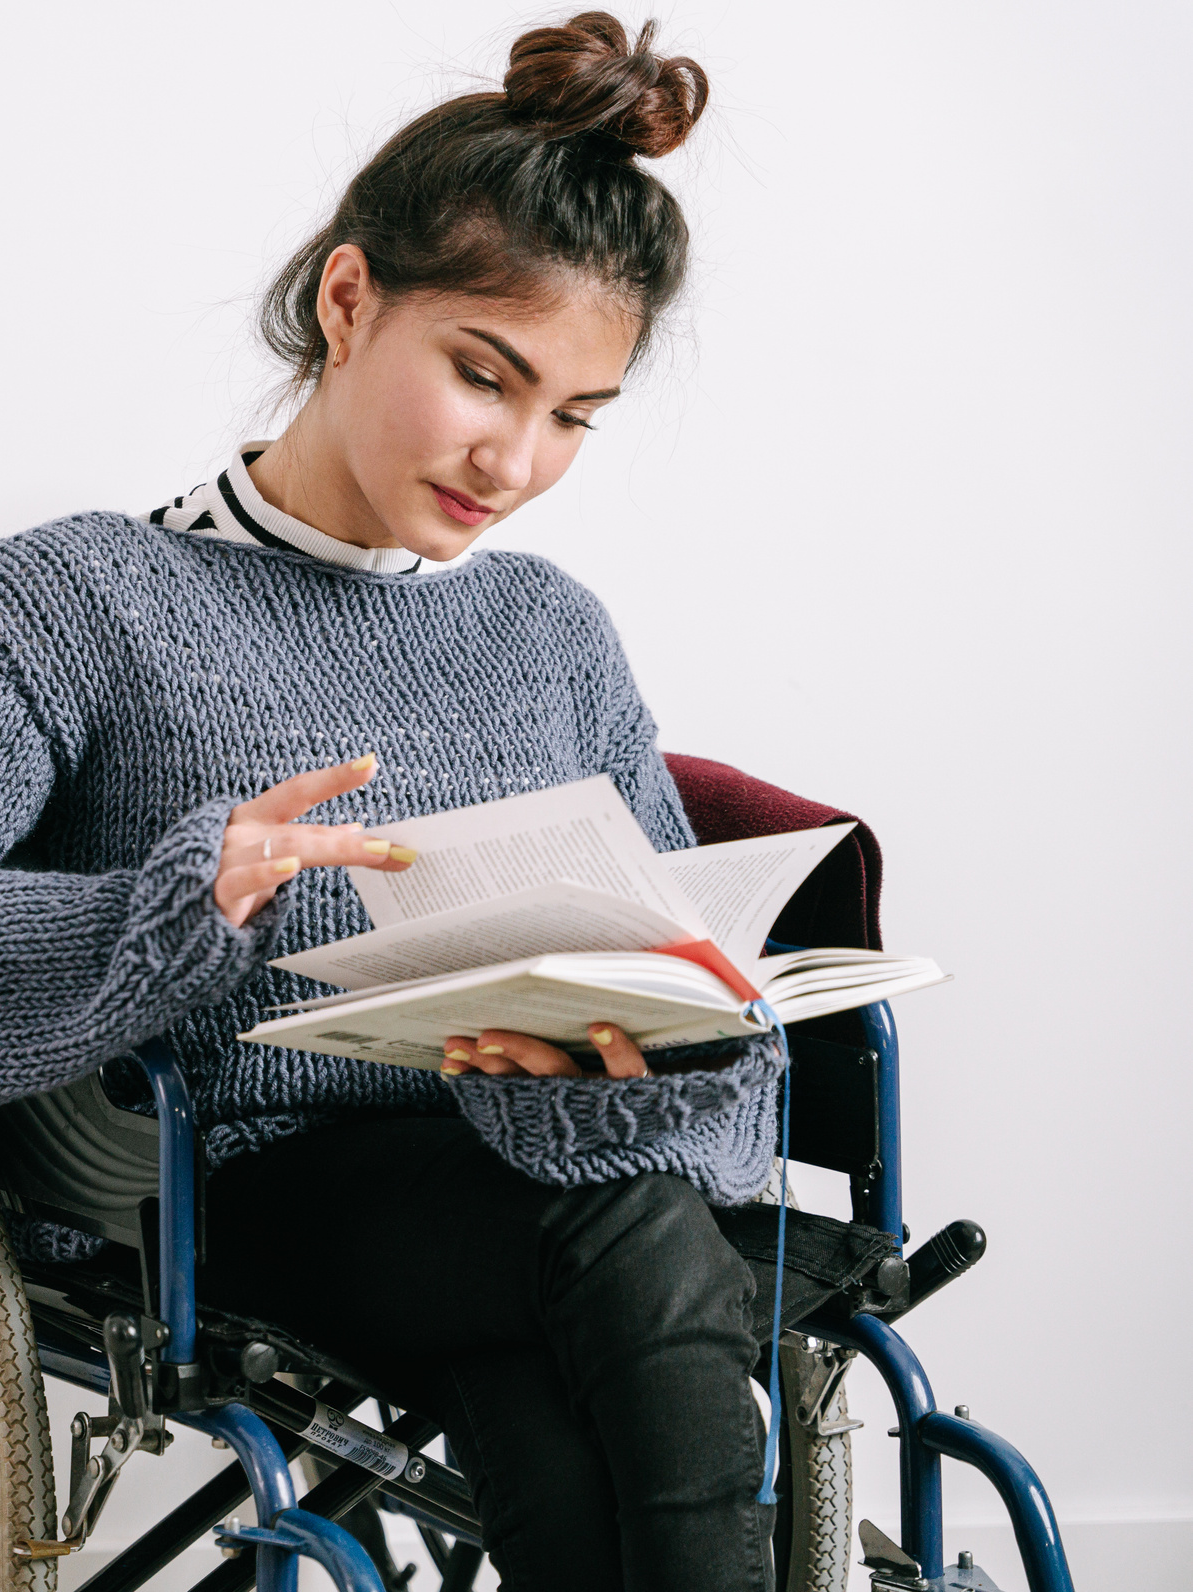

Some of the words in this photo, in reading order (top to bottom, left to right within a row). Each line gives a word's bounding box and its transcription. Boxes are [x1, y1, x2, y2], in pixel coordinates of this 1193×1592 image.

[310, 1422, 349, 1446] ПЕТРОВИЧ
[310, 1431, 343, 1448] ПРОКАТ
[373, 1440, 384, 1451] 100
